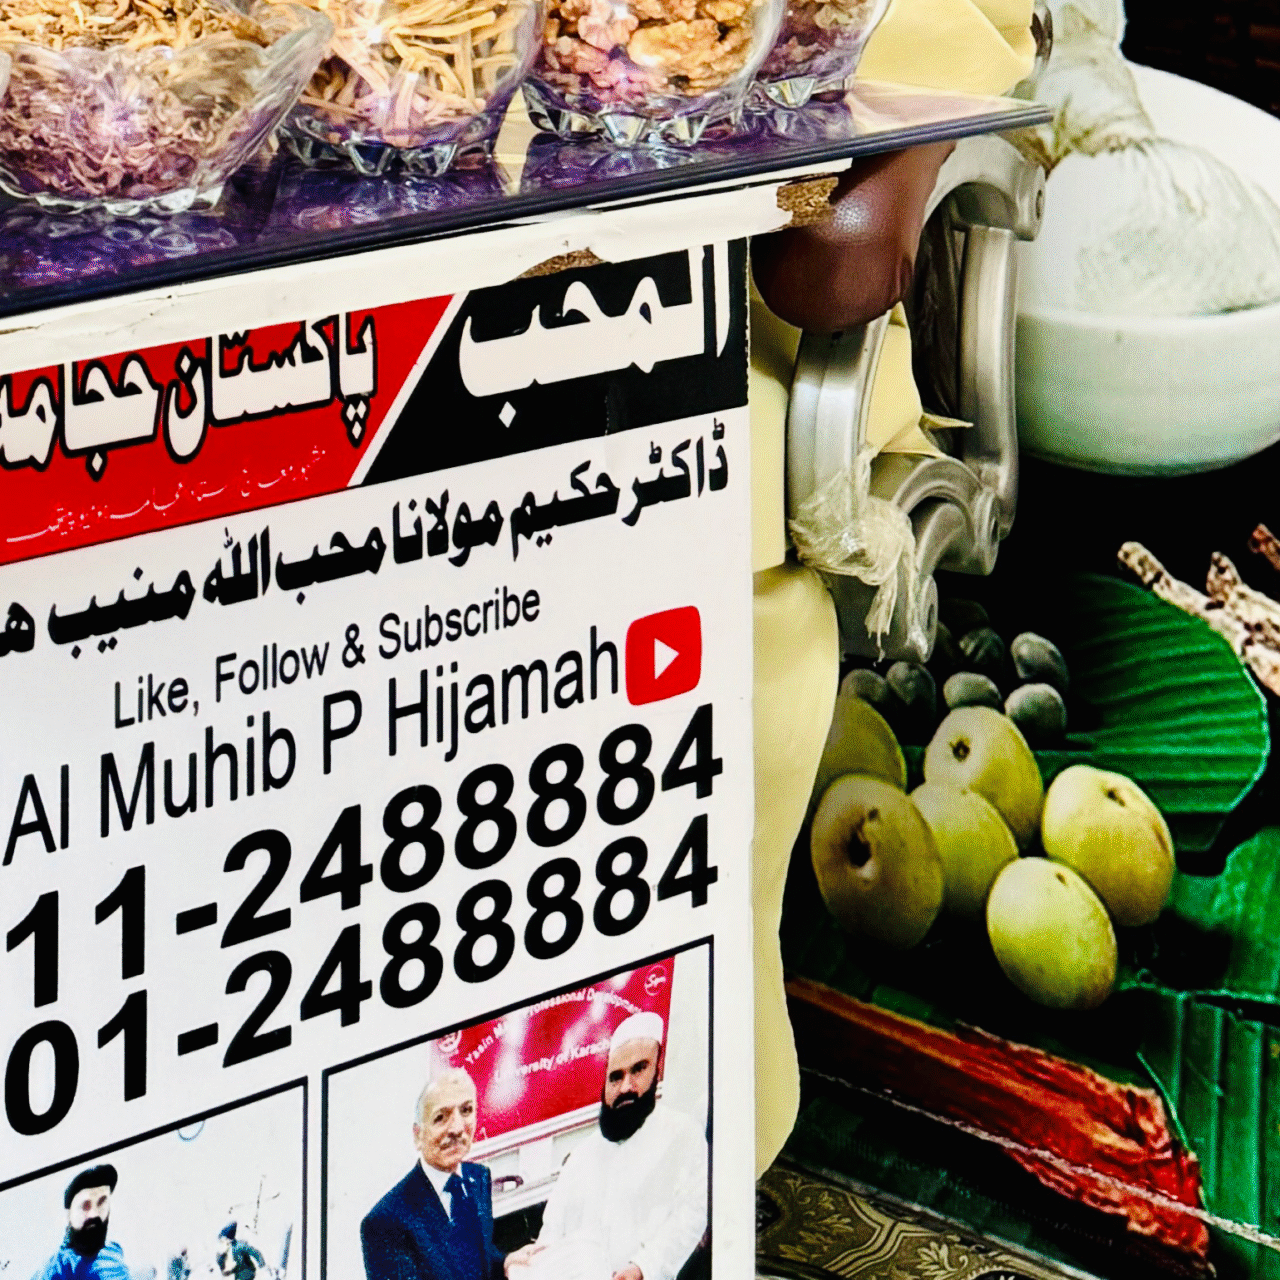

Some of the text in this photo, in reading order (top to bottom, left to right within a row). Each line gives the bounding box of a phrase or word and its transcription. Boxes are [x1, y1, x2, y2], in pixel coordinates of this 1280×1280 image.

[163, 308, 378, 448] پاکستان
[458, 240, 733, 429] المحب
[510, 459, 621, 562] حکیم
[622, 418, 729, 526] ڈاکٹر
[274, 525, 387, 605] محب
[392, 489, 504, 568] مولانا
[47, 565, 197, 660] منیب
[114, 585, 541, 729] Like, Follow & Subscribe
[2, 624, 619, 867] Al Muhib P Hijamah
